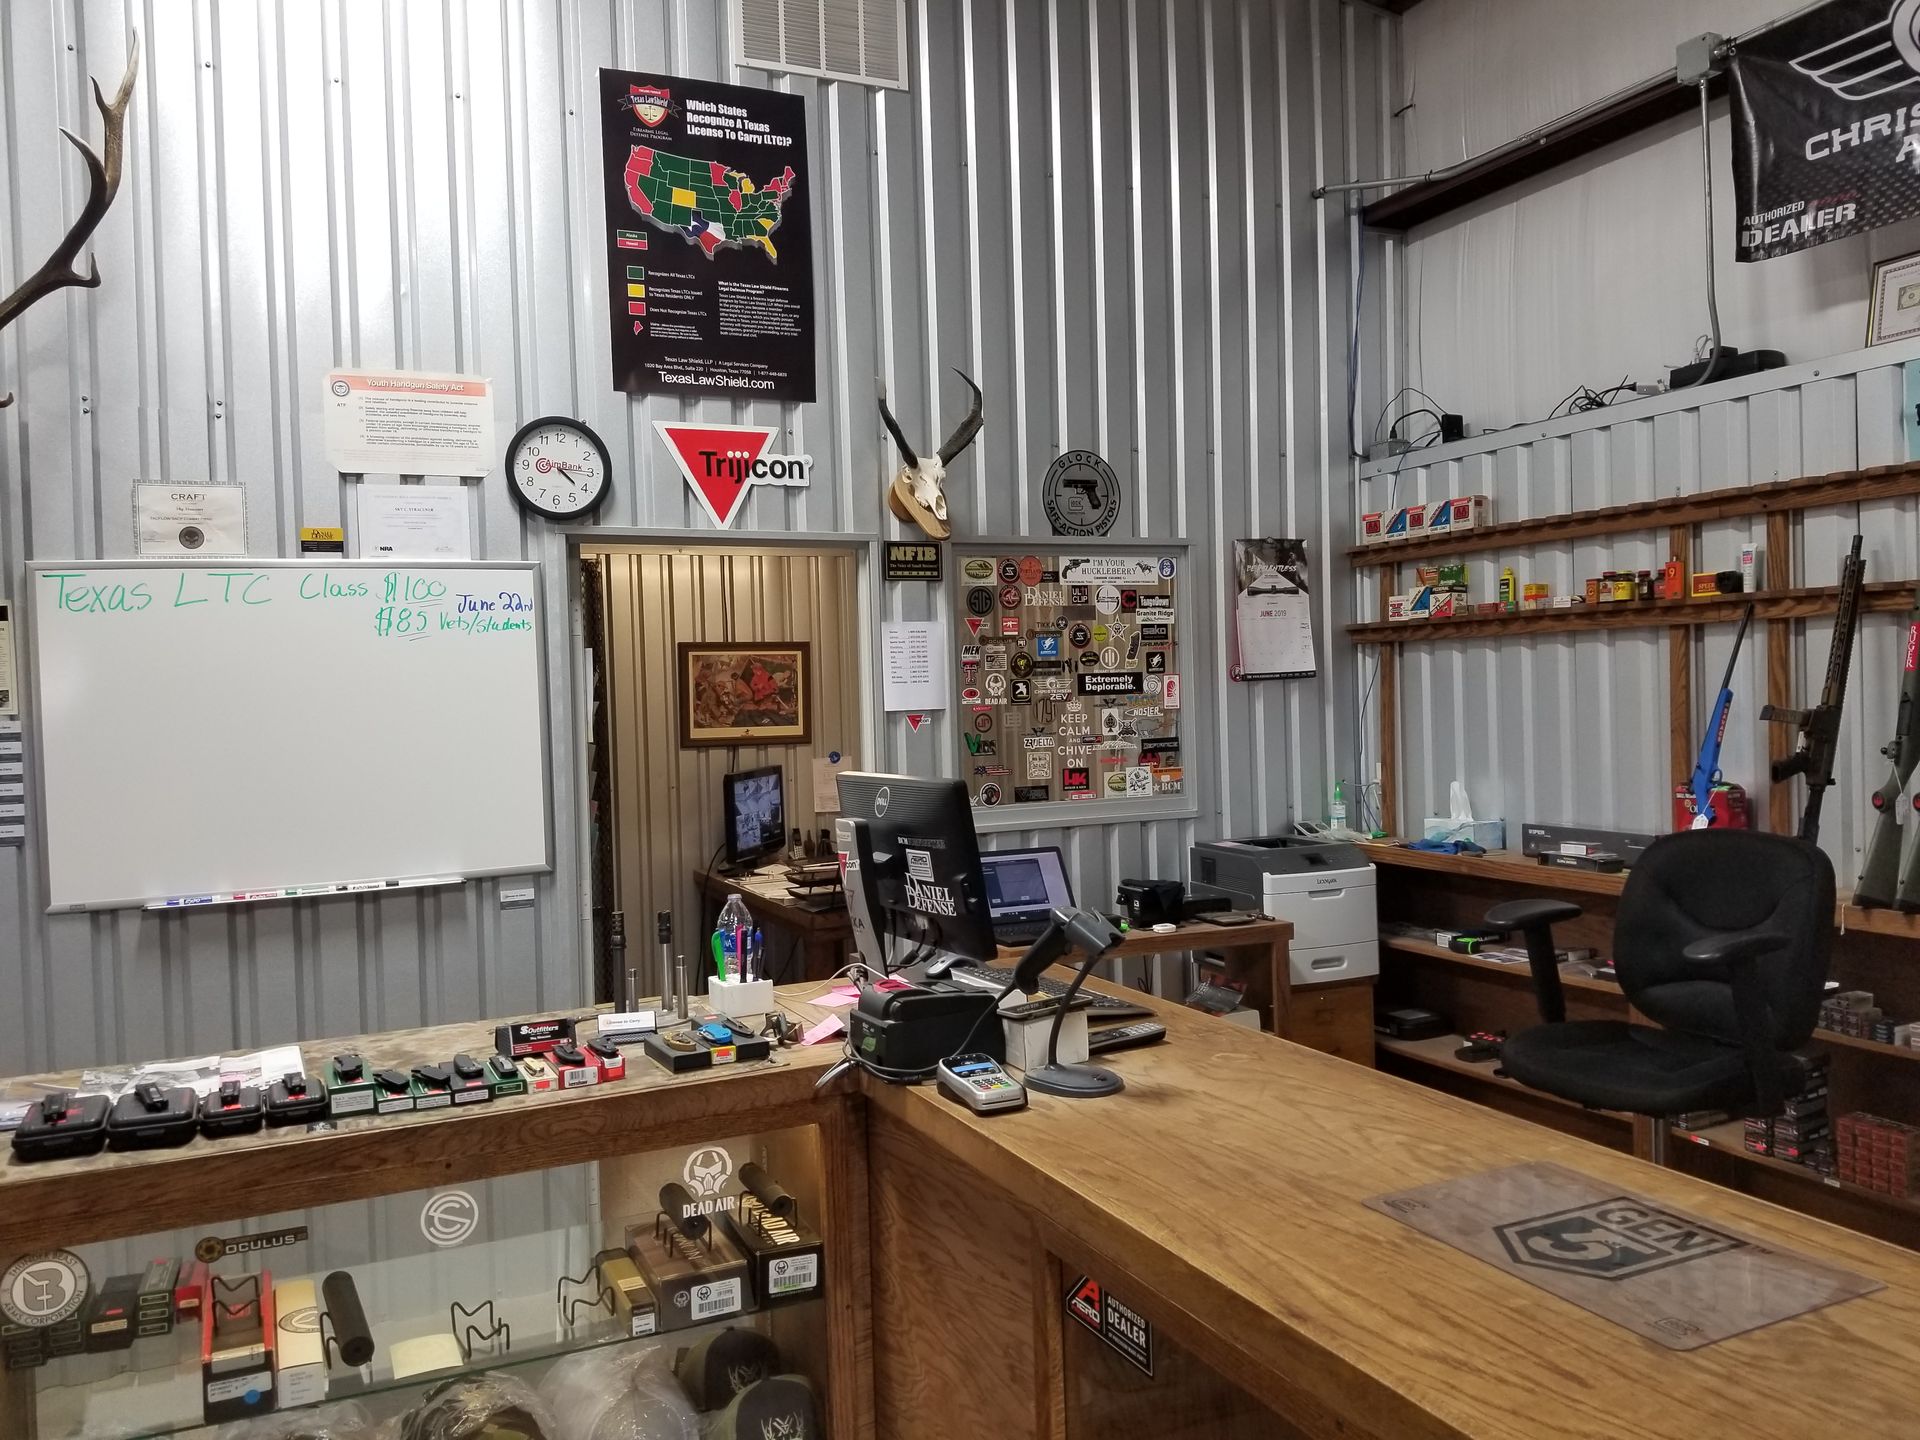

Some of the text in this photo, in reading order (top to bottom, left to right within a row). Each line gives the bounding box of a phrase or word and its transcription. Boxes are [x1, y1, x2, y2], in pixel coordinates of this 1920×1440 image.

[686, 99, 747, 117] Which States
[687, 112, 770, 132] Recognize A Texas
[687, 125, 792, 146] License To Carry (LTC)?
[1743, 200, 1805, 226] AUTHORIZED
[1742, 203, 1857, 247] DEALER
[367, 378, 464, 392] Youth Handgun Safety Act
[658, 371, 774, 389] TexasLawShield.com
[539, 435, 549, 445] 11
[555, 433, 566, 443] 12
[574, 439, 578, 448] 1
[527, 447, 540, 456] 10
[583, 451, 590, 461] 2
[522, 460, 529, 470] 9
[699, 450, 804, 484] Trijicon
[1059, 454, 1101, 468] GLOCK
[586, 468, 594, 477] 3
[526, 476, 534, 486] 8
[581, 483, 588, 493] 4
[539, 488, 546, 498] 7
[552, 495, 560, 505] 6
[568, 493, 576, 502] 5
[1048, 500, 1116, 536] SAFE-ACTION PISTOLS
[890, 546, 936, 561] NFIB
[1669, 568, 1675, 577] 9
[42, 571, 447, 613] Texas LTC Class $100
[1027, 587, 1064, 599] DANIEL
[456, 593, 496, 613] June
[969, 591, 991, 613] SIG
[1024, 594, 1066, 606] DEFENSE
[375, 606, 427, 636] $85
[1143, 625, 1166, 635] sako
[1906, 626, 1917, 667] RUGER
[1086, 683, 1136, 692] Deplorable.
[1133, 707, 1163, 716] NOSLER
[1060, 714, 1088, 724] KEEP
[1059, 727, 1090, 736] CALM
[1058, 746, 1092, 755] CHIVE
[1067, 759, 1083, 768] ON
[1162, 782, 1181, 790] BCM
[905, 872, 954, 902] DANIEL
[904, 885, 956, 916] DEFENSE
[682, 1196, 735, 1218] DEAD AIR
[1595, 1206, 1725, 1254] GEN
[225, 1234, 296, 1254] OCULUS
[24, 1290, 84, 1324] CORPORATION
[1108, 1296, 1145, 1329] AUTHORIZED
[1108, 1308, 1146, 1348] DEALER
